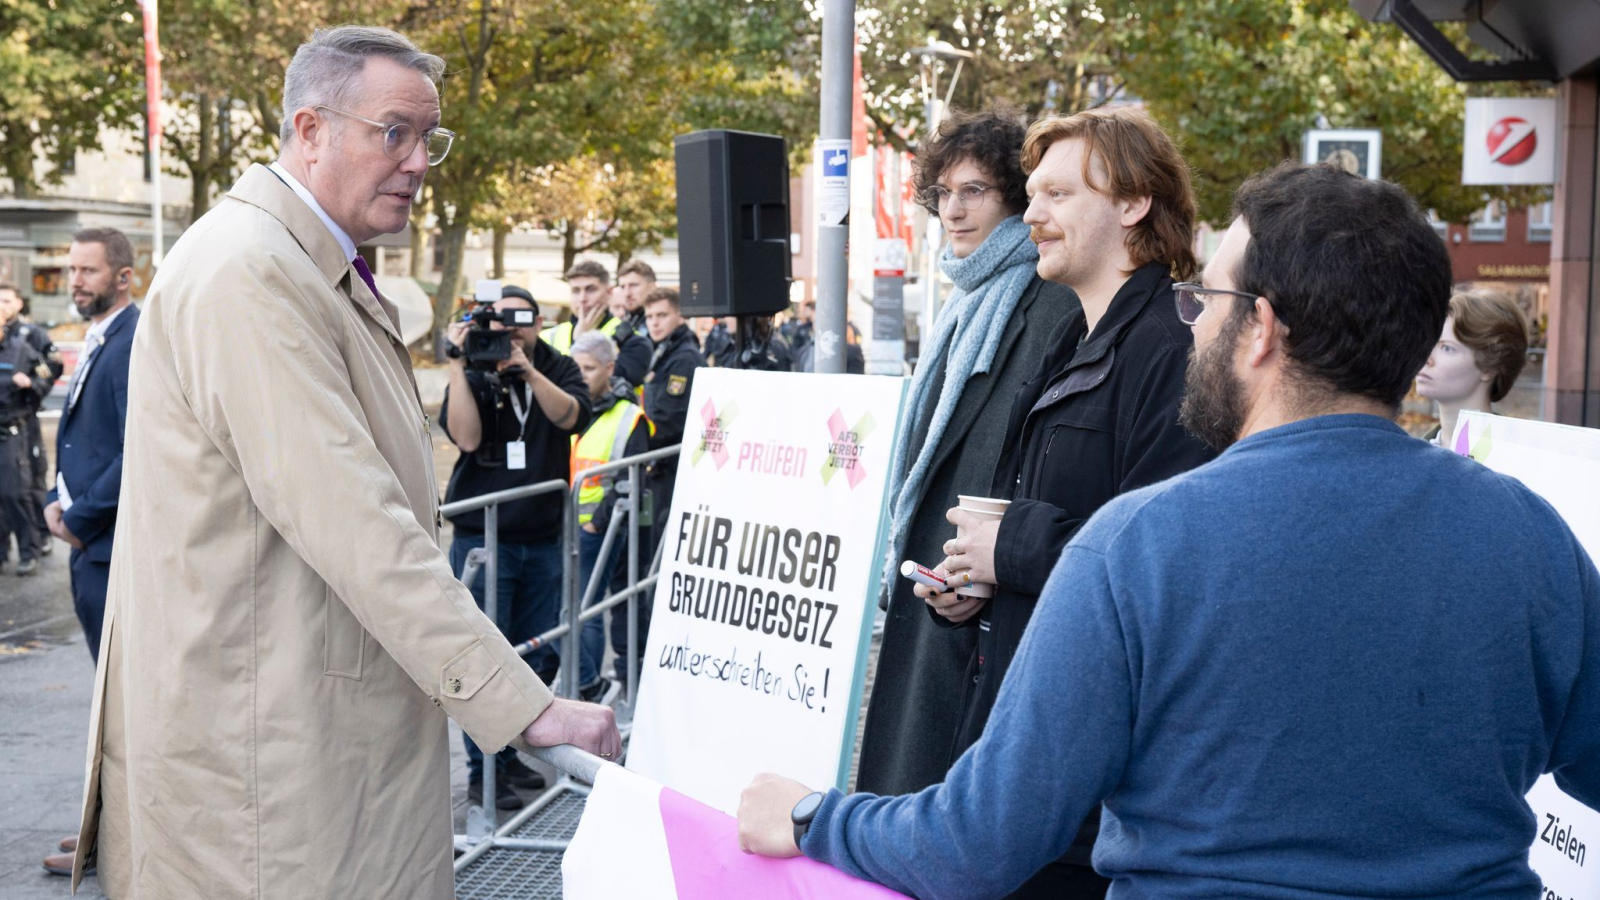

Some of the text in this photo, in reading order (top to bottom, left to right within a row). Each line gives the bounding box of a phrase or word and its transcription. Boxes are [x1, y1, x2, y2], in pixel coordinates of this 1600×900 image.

[837, 430, 858, 443] AFD
[828, 443, 865, 457] VERBOT
[829, 457, 857, 470] JETZT
[659, 634, 782, 697] unterschreiben
[1540, 812, 1586, 868] Zielen
